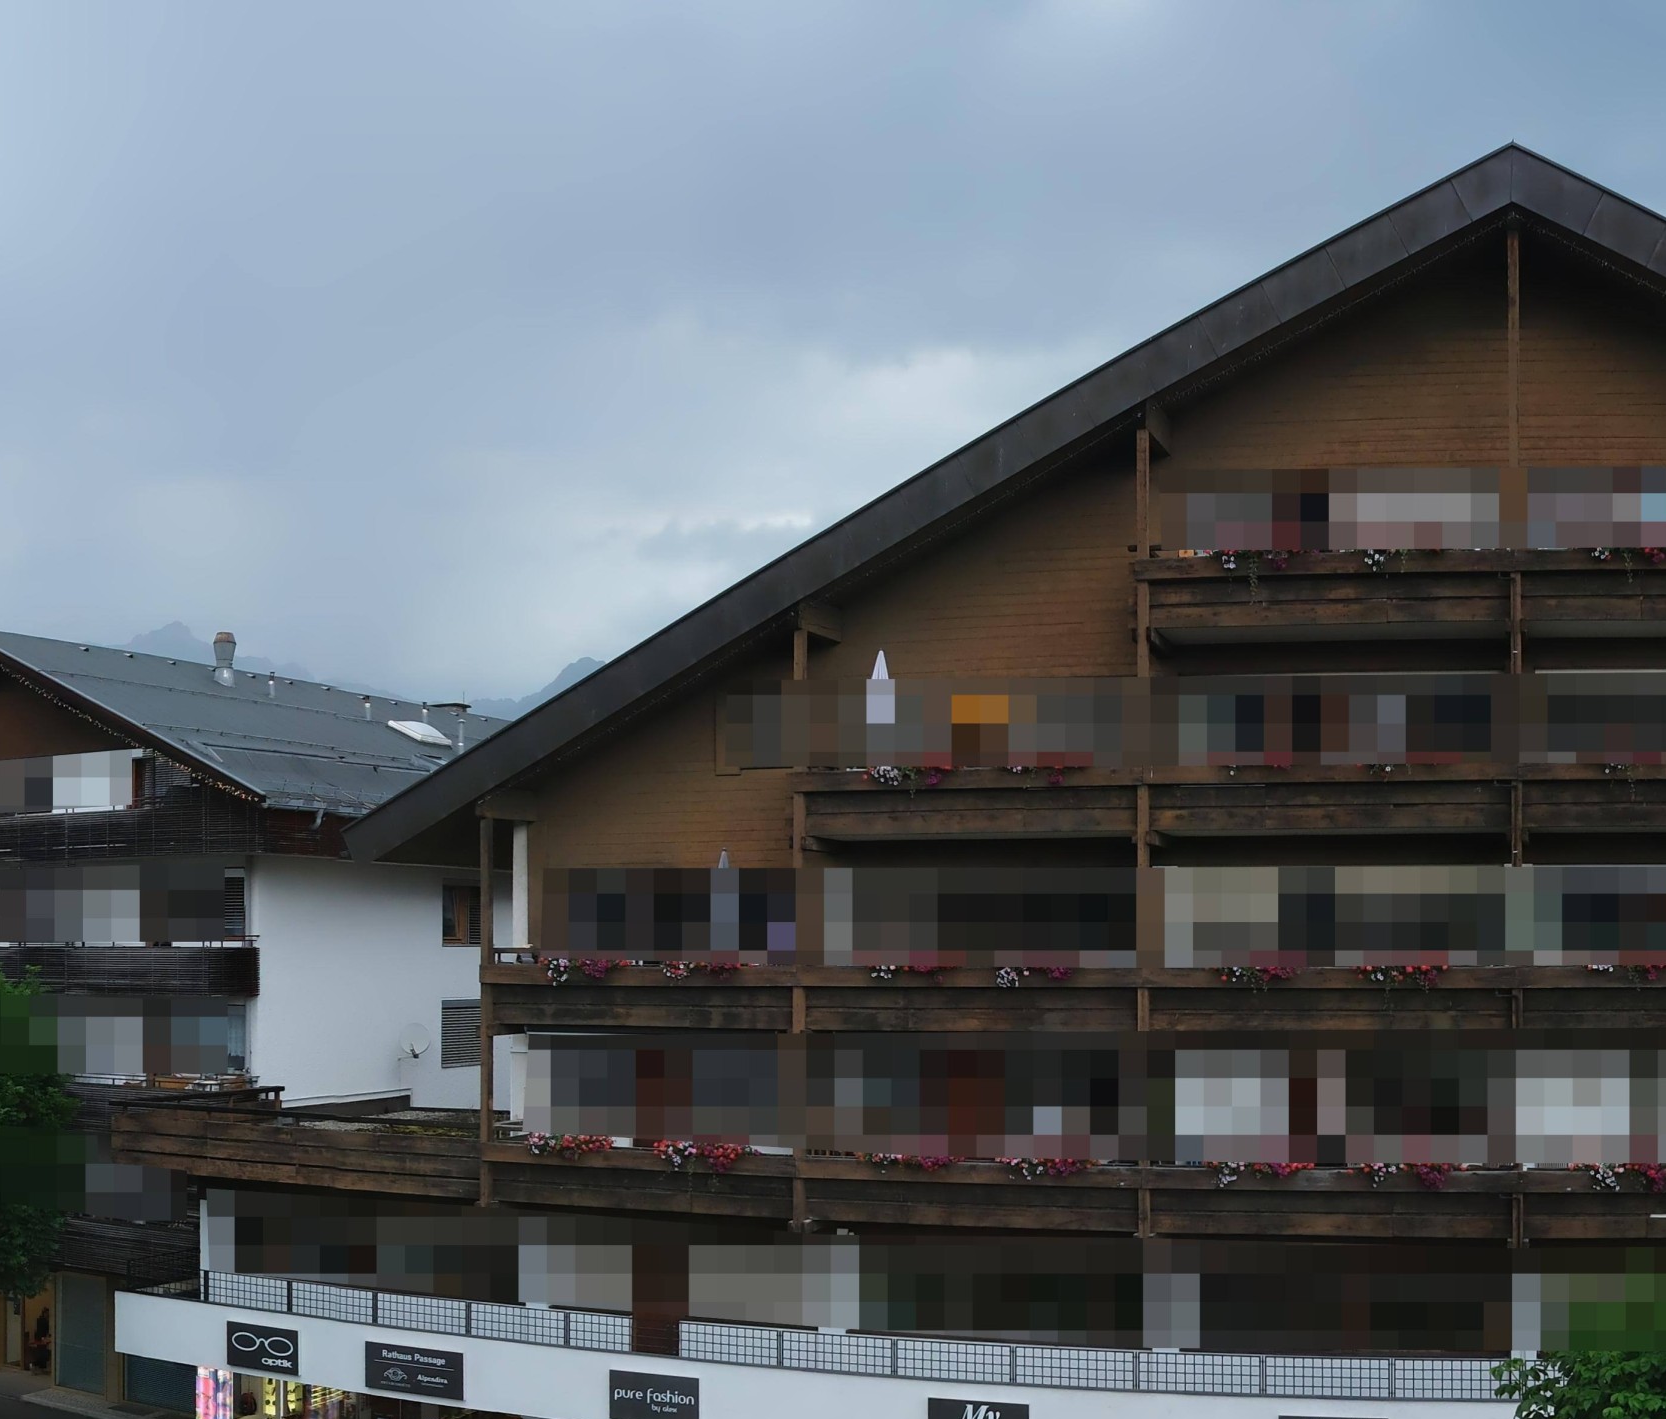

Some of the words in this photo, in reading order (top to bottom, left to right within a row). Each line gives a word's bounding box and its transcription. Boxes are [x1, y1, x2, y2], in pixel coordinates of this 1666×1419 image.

[261, 1357, 293, 1368] optik
[382, 1349, 412, 1361] Rathaus
[414, 1353, 446, 1366] Passage
[614, 1388, 643, 1400] pure
[647, 1388, 694, 1405] fashion
[651, 1404, 661, 1413] by
